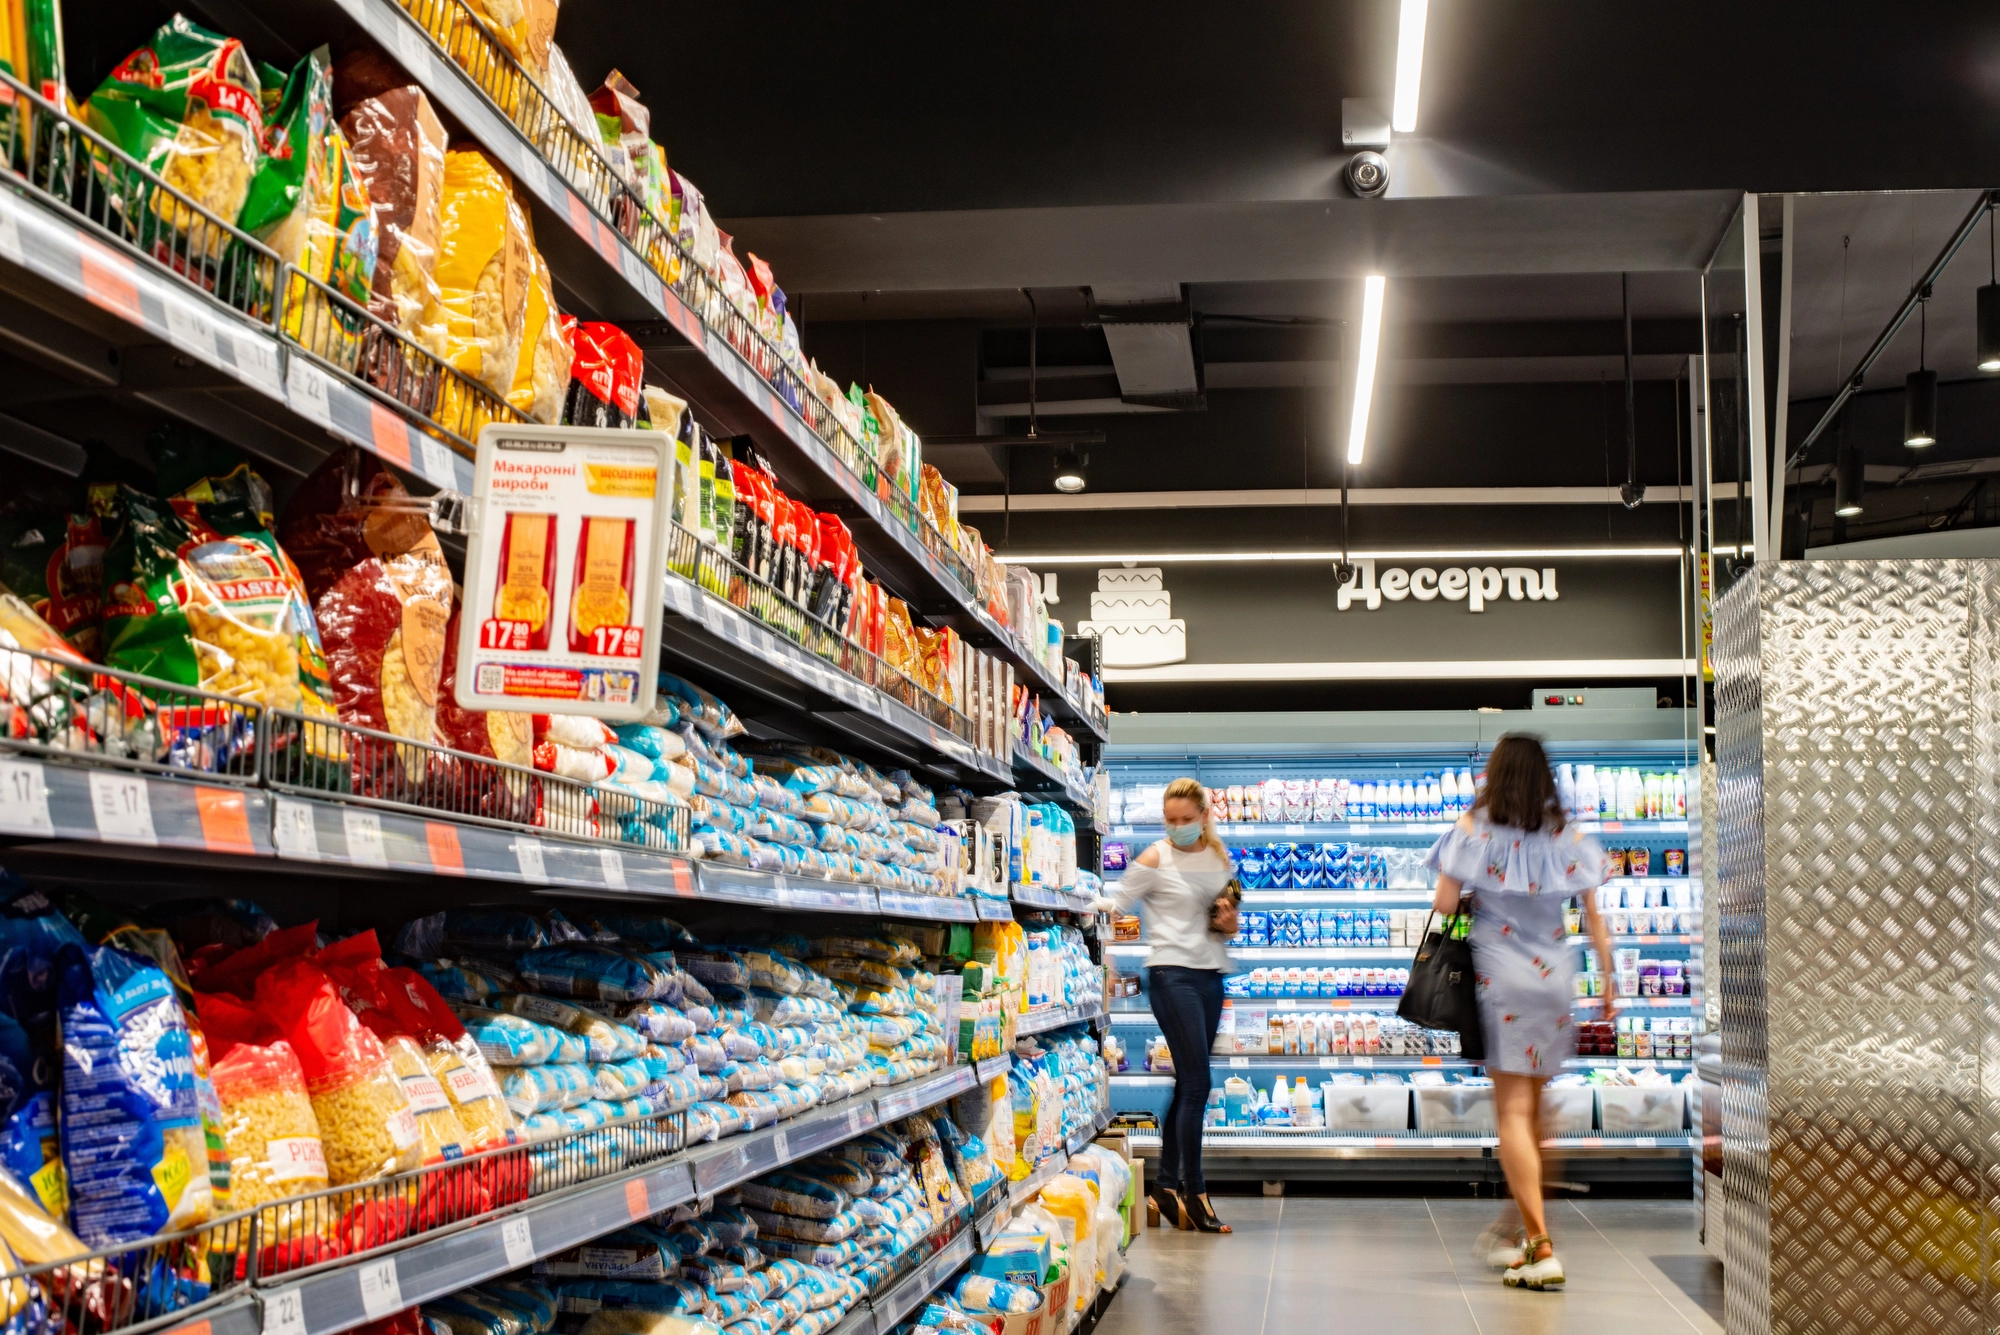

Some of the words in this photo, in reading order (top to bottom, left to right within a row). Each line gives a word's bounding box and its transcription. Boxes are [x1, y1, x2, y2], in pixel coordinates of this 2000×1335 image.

[306, 371, 320, 400] 22
[493, 460, 577, 476] Макаронні
[600, 468, 658, 480] ЩОДЕННА
[492, 476, 549, 492] вироби
[225, 580, 289, 599] PASTA
[1337, 558, 1559, 612] Десерти
[485, 620, 513, 648] 17
[513, 622, 529, 636] 80
[512, 638, 527, 649] грн
[593, 627, 623, 655] 17
[623, 629, 640, 643] 60
[622, 645, 638, 656] грн
[12, 770, 31, 802] 17
[121, 784, 138, 814] 17
[515, 1222, 527, 1244] 15
[377, 1265, 391, 1291] 14
[279, 1293, 295, 1325] 22
